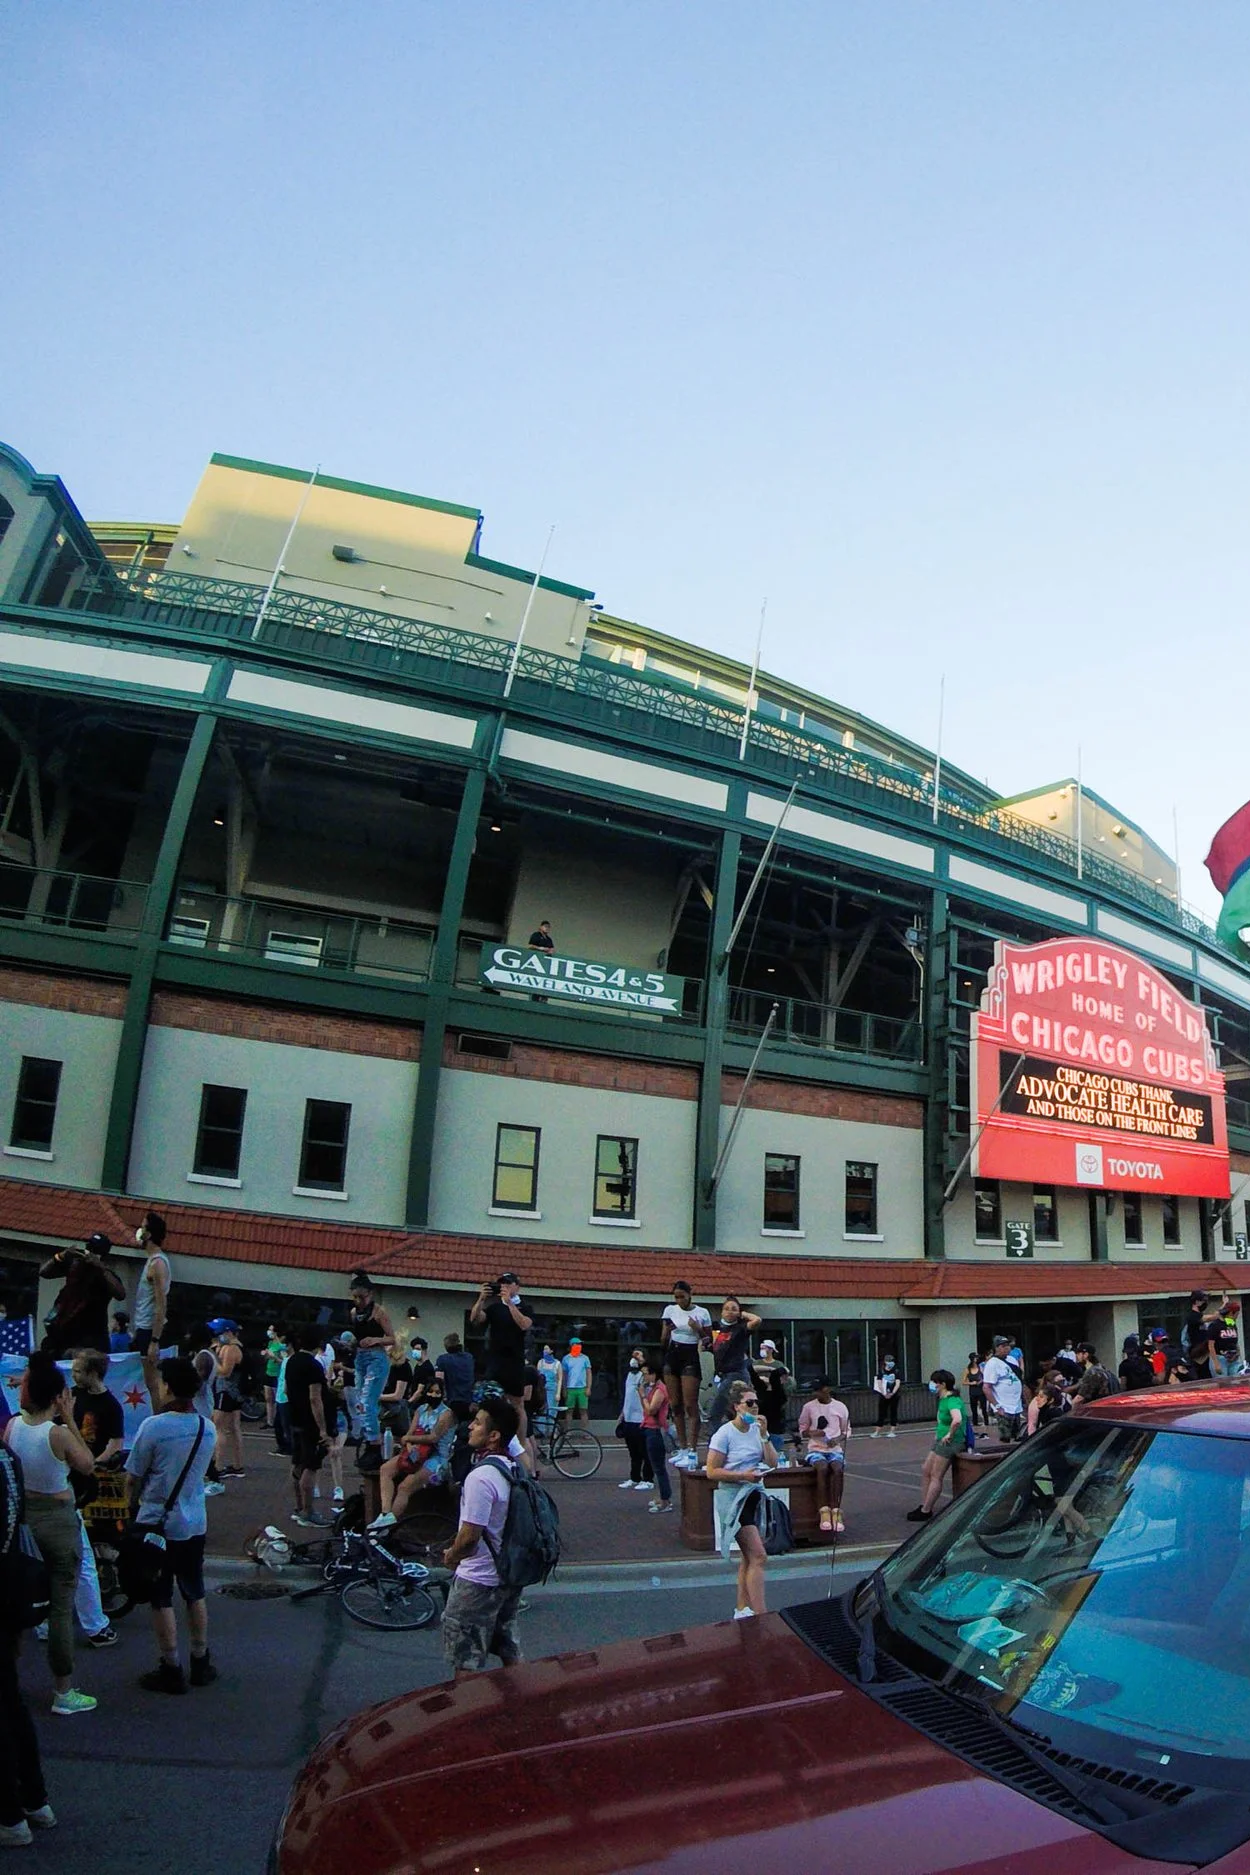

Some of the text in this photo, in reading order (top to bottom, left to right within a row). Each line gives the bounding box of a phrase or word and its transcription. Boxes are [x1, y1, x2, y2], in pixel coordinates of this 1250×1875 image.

[493, 949, 665, 993] GATES 4 & 5
[510, 972, 656, 1006] WAVELAND AVENUE
[1011, 952, 1200, 1044] WRIGLEY FIELD
[1071, 992, 1157, 1032] HOME OF
[1011, 1011, 1205, 1084] CHICAGO CUBS
[1016, 1074, 1204, 1127] ADVOCATE HEALTH CARE
[1056, 1066, 1175, 1104] CHICAGO CUBS THANK
[1026, 1098, 1197, 1140] AND THOSE ON THE FRONT LINES
[1107, 1158, 1164, 1180] TOYOTA
[1007, 1222, 1031, 1230] GATE
[1011, 1229, 1029, 1249] 3
[1237, 1238, 1246, 1254] 3
